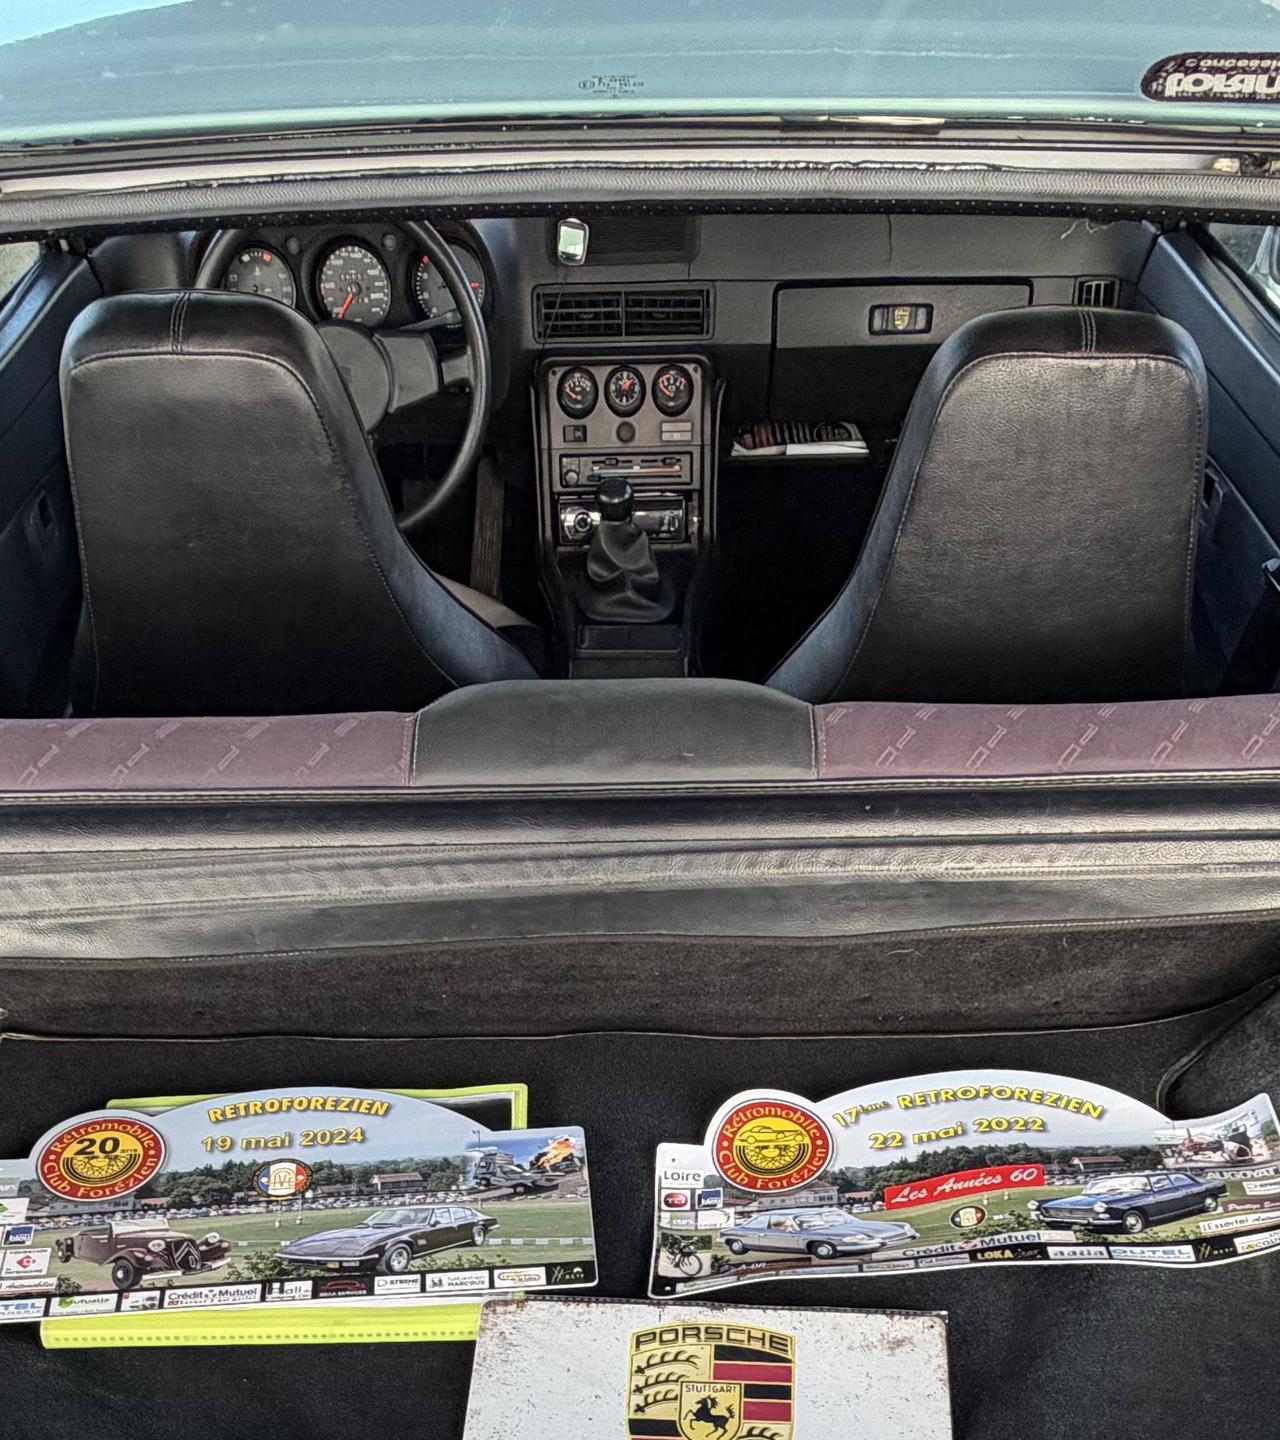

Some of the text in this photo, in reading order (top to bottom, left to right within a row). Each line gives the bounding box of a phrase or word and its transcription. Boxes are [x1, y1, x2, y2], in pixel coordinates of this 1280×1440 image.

[208, 1096, 391, 1122] RETROFOREZIEN
[897, 1086, 1105, 1119] RETROFOREZIEN
[722, 1106, 820, 1138] Rétromobile
[869, 1117, 1046, 1149] 22 mai 2022
[50, 1122, 155, 1153] Rétromobile
[73, 1136, 120, 1156] 20
[201, 1126, 365, 1152] 19 mai 2024
[44, 1158, 157, 1199] Club Forézien
[664, 1170, 702, 1181] Loire
[720, 1148, 827, 1189] Club Forézien
[1206, 1166, 1276, 1180] AUGOYAT
[891, 1167, 1038, 1204] Les Années 60
[902, 1232, 1042, 1257] Crédit Mutuel
[976, 1249, 1014, 1261] LOKA
[168, 1287, 258, 1301] Crédit Mutuel
[634, 1326, 791, 1354] PORSCHE
[684, 1383, 738, 1394] STUTTGART
